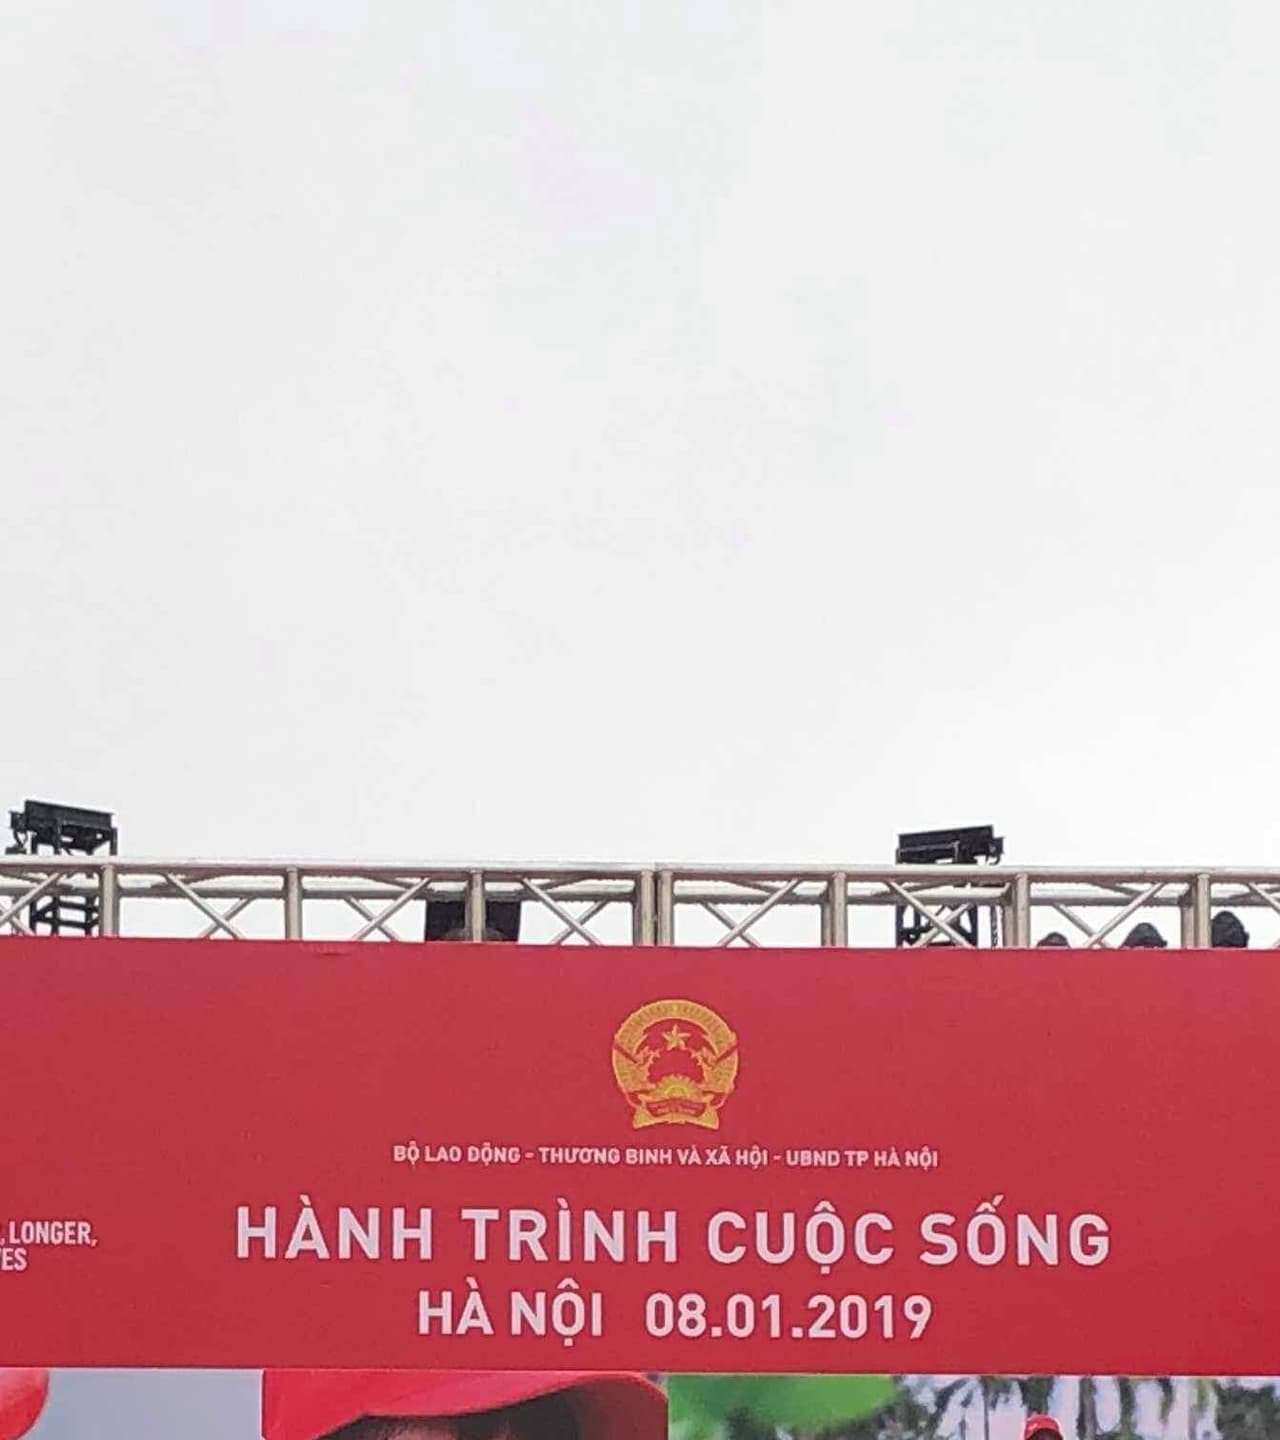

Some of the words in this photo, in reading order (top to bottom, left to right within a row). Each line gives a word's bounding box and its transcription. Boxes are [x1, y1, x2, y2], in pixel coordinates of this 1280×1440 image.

[393, 1140, 420, 1166] BỘ
[424, 1145, 462, 1162] LAO
[467, 1141, 521, 1166] ĐỘNG
[538, 1146, 621, 1165] THƯƠNG
[625, 1148, 673, 1165] BINH
[676, 1144, 702, 1166] VÀ
[705, 1145, 732, 1166] XÃ
[735, 1144, 768, 1169] HỘI
[785, 1149, 841, 1167] UBND
[843, 1150, 870, 1167] TP
[873, 1146, 901, 1167] HÀ
[904, 1145, 938, 1170] NỘI
[9, 1221, 98, 1248] LONGER,
[237, 1194, 432, 1260] HÀNH
[461, 1197, 677, 1264] TRÌNH
[707, 1200, 894, 1275] CUỘC
[919, 1194, 1109, 1266] SỐNG
[418, 1276, 494, 1336] HÀ
[511, 1277, 602, 1347] NỘI
[645, 1292, 932, 1339] 08.01.2019
